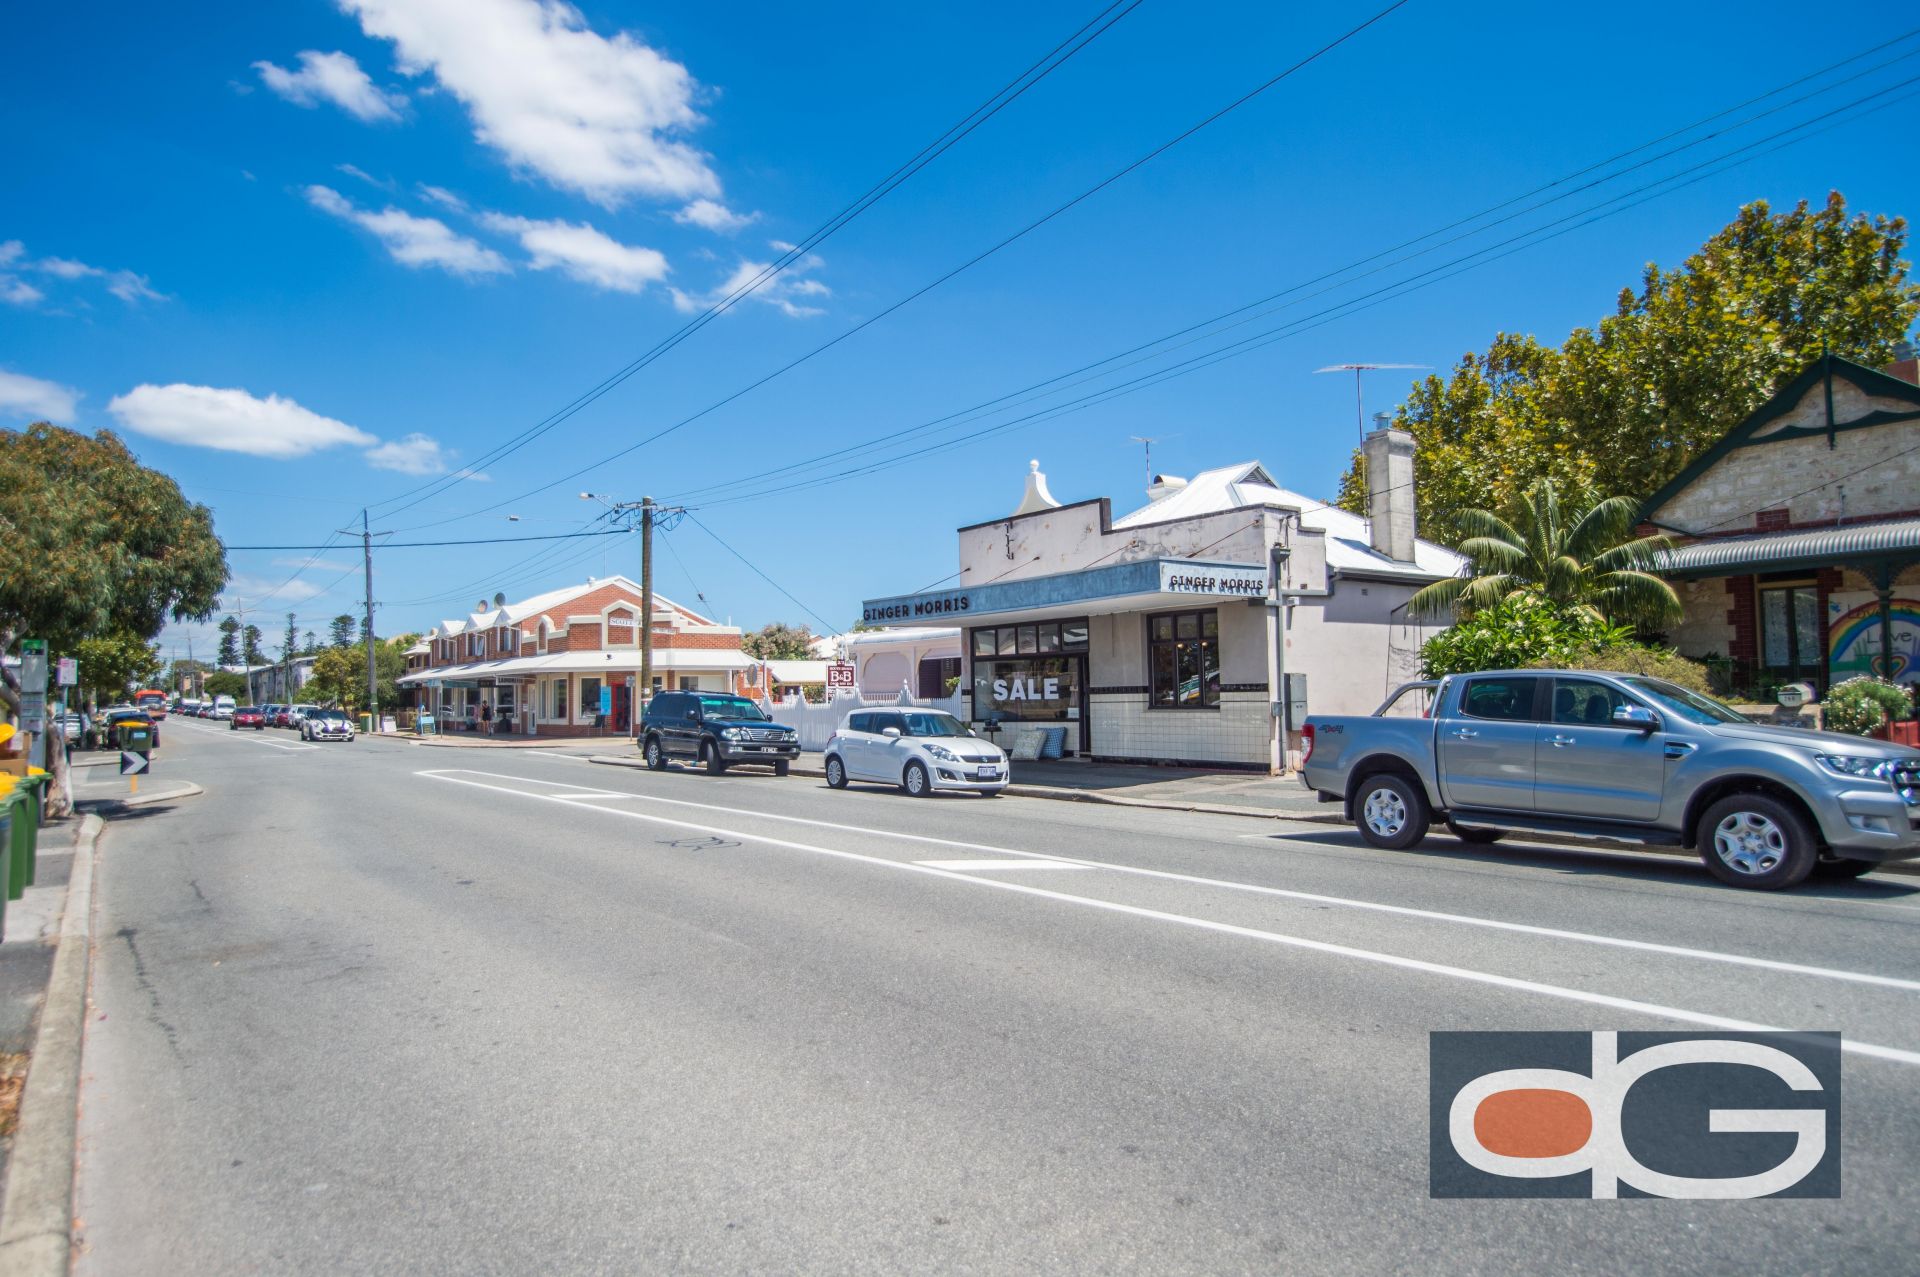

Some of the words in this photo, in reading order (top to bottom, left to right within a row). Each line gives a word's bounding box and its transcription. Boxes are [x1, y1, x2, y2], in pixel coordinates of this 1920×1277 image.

[1170, 575, 1216, 588] GINGER
[1221, 579, 1264, 590] MORRIS
[863, 604, 910, 621] GINGER
[915, 596, 969, 615] MORRIS
[1867, 629, 1912, 644] Lve
[830, 670, 852, 682] B&B
[993, 677, 1059, 701] SALE
